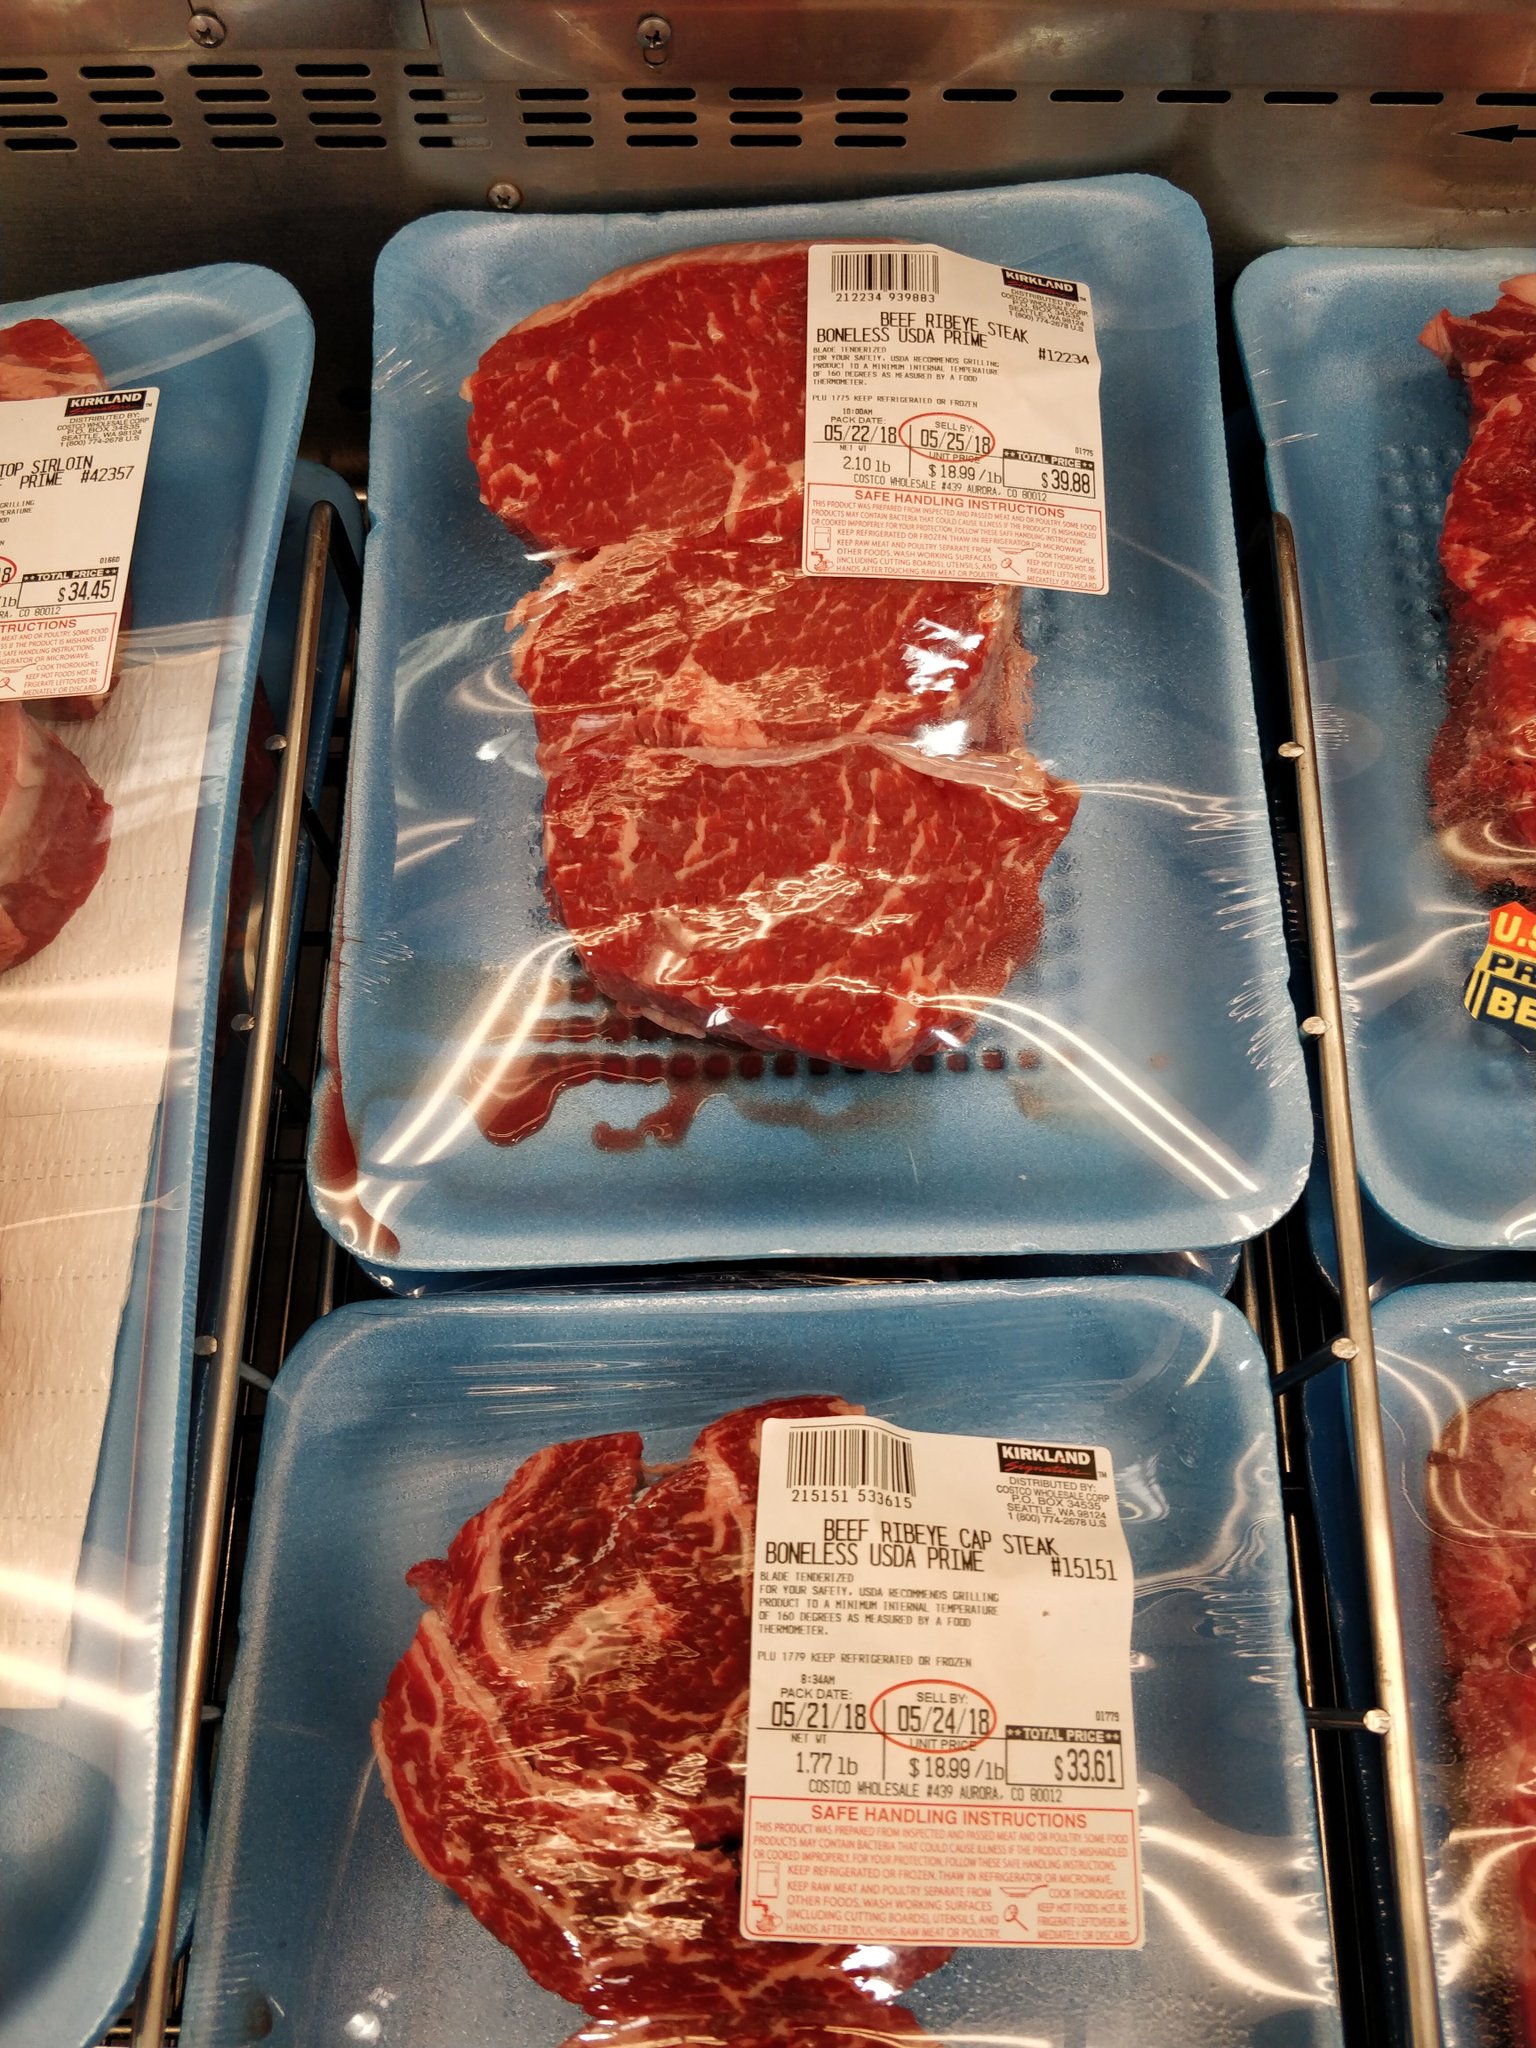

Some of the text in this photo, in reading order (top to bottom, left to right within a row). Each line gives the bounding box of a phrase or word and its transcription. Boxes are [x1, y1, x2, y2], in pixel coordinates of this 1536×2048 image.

[1005, 270, 1074, 292] KIRKLAND
[836, 292, 935, 303] 212234 939883
[1011, 289, 1063, 305] DISTRIBUTED
[880, 312, 1029, 344] BEEF RIBEYE STEAK
[816, 327, 988, 348] BONELESS USDA PRIME
[1038, 347, 1089, 365] #12234
[70, 393, 142, 407] KIRKLAND
[70, 413, 125, 424] DISTRIBUTED
[831, 416, 856, 424] PACK
[935, 421, 958, 430] SELL
[824, 424, 991, 454] 05/22/18 05/25/18
[0, 455, 93, 477] TOP SIRLOIN
[843, 456, 891, 473] 2.10 lb
[1017, 452, 1082, 469] TOTAL PRICE
[19, 465, 135, 490] PRIME #42357
[928, 464, 976, 480] $18.99
[853, 473, 886, 486] COSTCO
[890, 476, 936, 490] WHOLESALE
[941, 481, 963, 492] #439
[1007, 488, 1017, 499] CO
[1022, 490, 1047, 502] 80012
[1041, 469, 1091, 494] $39.88
[855, 490, 1065, 519] SAFE HANDLING INSTRUCTIONS
[37, 568, 104, 581] TOTAL PRICE
[58, 579, 111, 602] $34.45
[19, 607, 61, 618] CO 80012
[1494, 911, 1536, 951] U.
[1001, 1445, 1091, 1465] KIRKLAND
[1009, 1476, 1077, 1491] DISTRIBUTED
[791, 1489, 912, 1509] 215151 533615
[996, 1484, 1032, 1496] COSTCO
[1033, 1488, 1085, 1501] WHOLESALE
[1037, 1496, 1063, 1508] BOX
[1016, 1511, 1041, 1524] (800)
[1059, 1508, 1076, 1518] WA
[1077, 1509, 1107, 1520] 98124
[824, 1518, 1060, 1556] BEEF RIBEYE CAP STEAK
[765, 1541, 985, 1572] BONELESS USDA PRIME
[760, 1571, 854, 1583] BLADE TENDERIZED
[1051, 1556, 1118, 1581] #15151
[759, 1585, 778, 1594] FOR
[783, 1585, 807, 1595] YOUR
[859, 1587, 883, 1597] USDA
[888, 1588, 948, 1600] RECOMMENDS
[952, 1591, 999, 1602] GRILLING
[759, 1597, 999, 1616] PRODUCT TO A MINIMUM INTERNAL TEMPERATURE
[758, 1611, 971, 1627] OF 160 DEGREES AS MEASURED BY A FOOD
[757, 1651, 972, 1668] PLU 1779 KEEP REFRIGERATED OR FROZEN
[780, 1687, 852, 1700] PACK DATE:
[916, 1692, 968, 1705] SELL BY:
[771, 1701, 990, 1735] 05/21/18 05/24/18
[791, 1733, 827, 1744] NET WT
[1023, 1727, 1105, 1743] TOTAL PRICE
[909, 1738, 938, 1750] UNIT
[796, 1751, 859, 1775] 1.77 lb
[909, 1756, 970, 1779] $18.99
[1054, 1748, 1116, 1783] $33.61
[809, 1779, 851, 1794] COSTCO
[857, 1781, 920, 1798] WHOLESALE
[926, 1784, 953, 1799] #439
[1011, 1787, 1025, 1801] CO
[1030, 1788, 1063, 1803] 80012
[811, 1804, 1087, 1829] SAFE HANDLING INSTRUCTIONS
